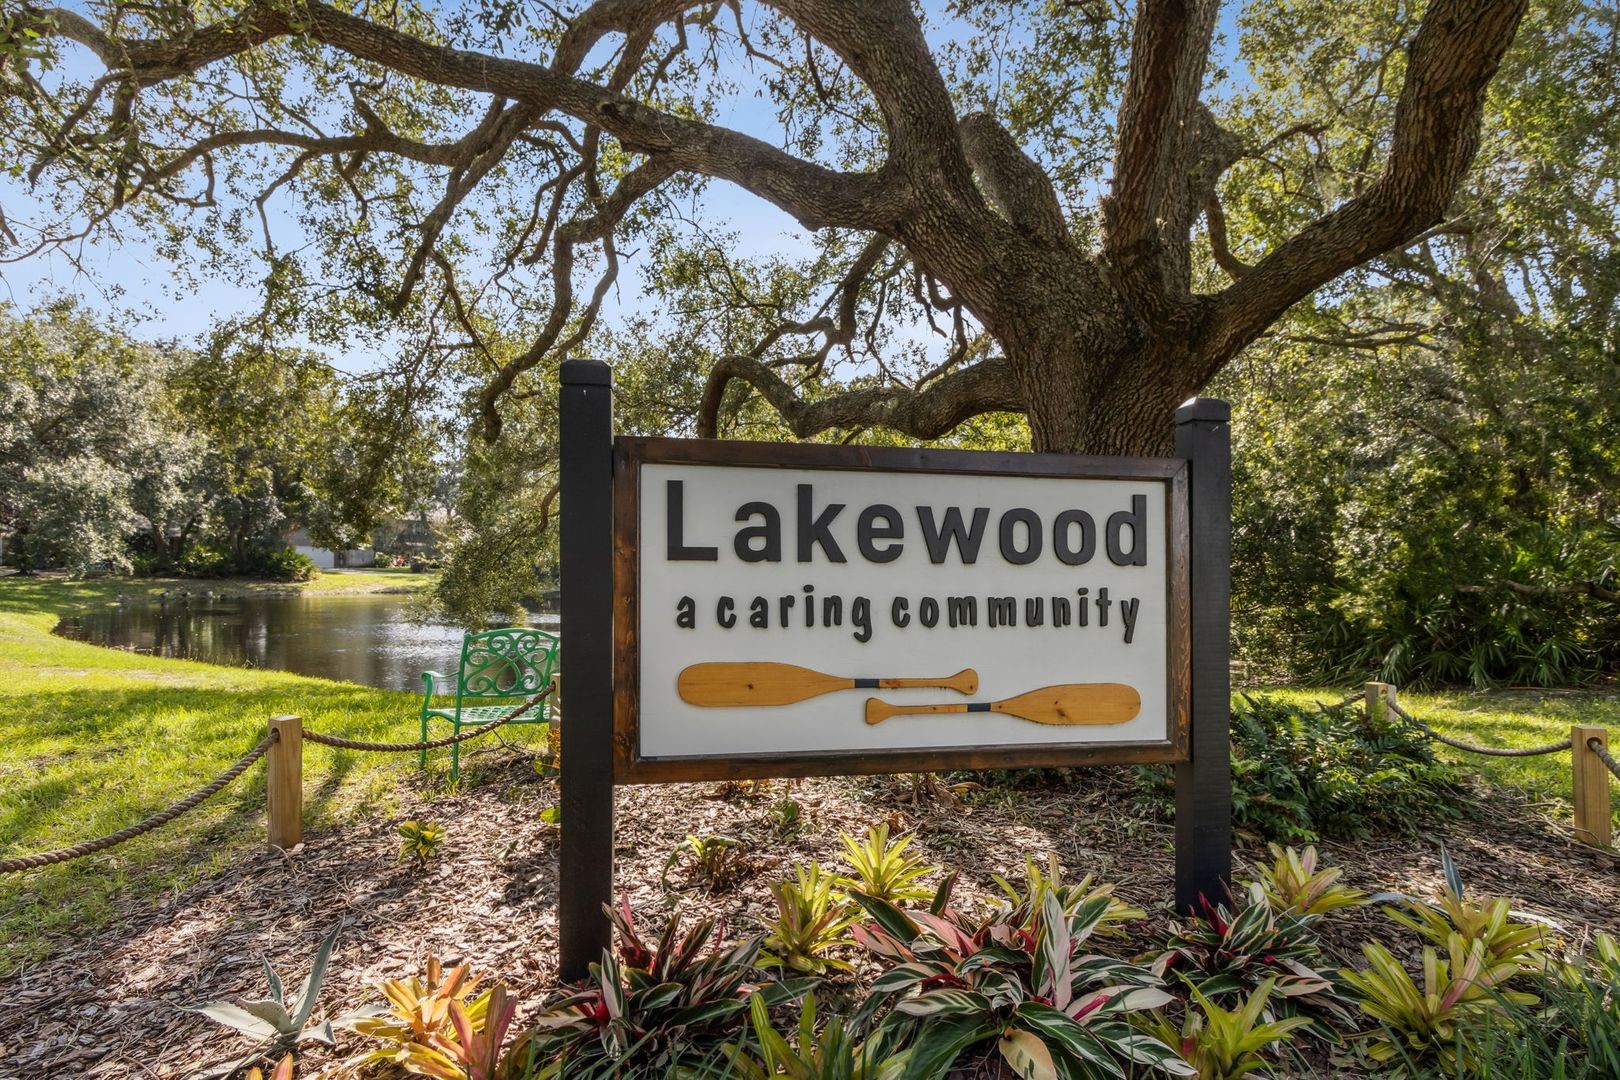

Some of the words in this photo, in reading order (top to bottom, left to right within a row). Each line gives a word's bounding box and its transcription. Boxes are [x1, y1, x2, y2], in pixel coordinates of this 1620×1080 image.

[666, 479, 1148, 567] Lakewood
[676, 595, 696, 630] a
[716, 584, 873, 644] caring
[890, 586, 1140, 645] community
